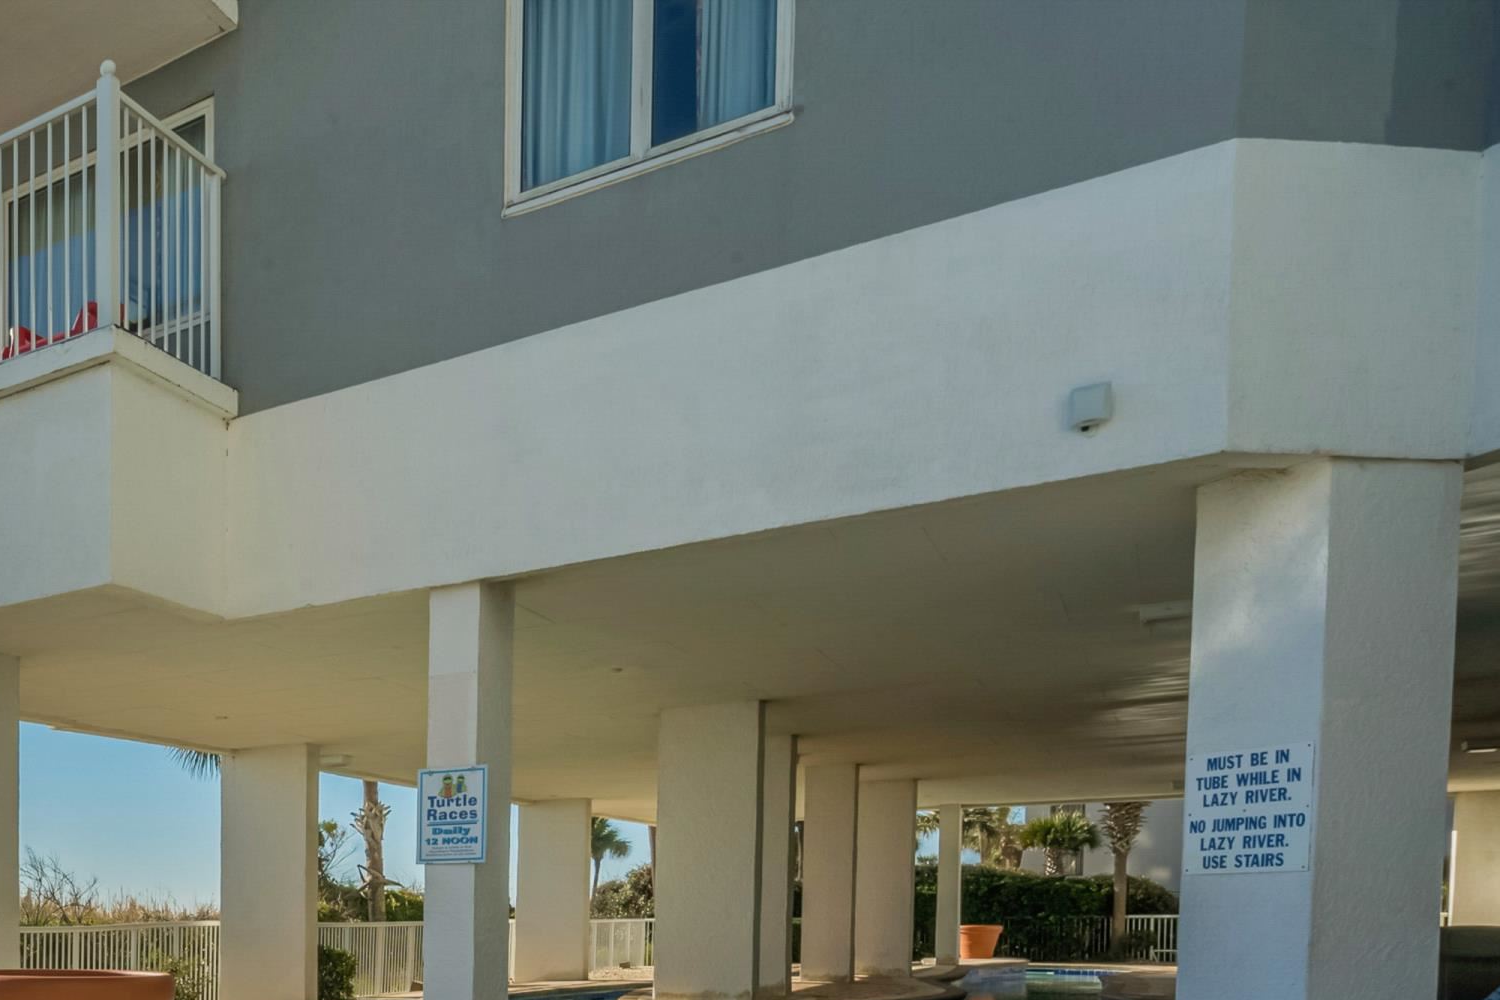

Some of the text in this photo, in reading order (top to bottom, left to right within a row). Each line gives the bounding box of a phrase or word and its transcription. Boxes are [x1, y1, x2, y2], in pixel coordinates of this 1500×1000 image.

[1206, 749, 1290, 772] MUST BE IN
[1196, 767, 1301, 791] TUBE WHILE IN
[427, 794, 478, 808] Turtle
[1203, 787, 1292, 808] LAZY RIVER.
[427, 809, 478, 821] Races
[1189, 813, 1306, 834] NO JUMPING INTO
[431, 826, 471, 836] Daily
[425, 836, 478, 846] 12 NOON
[1200, 833, 1289, 852] LAZY RIVER.
[1202, 852, 1284, 870] USE STAIRS
